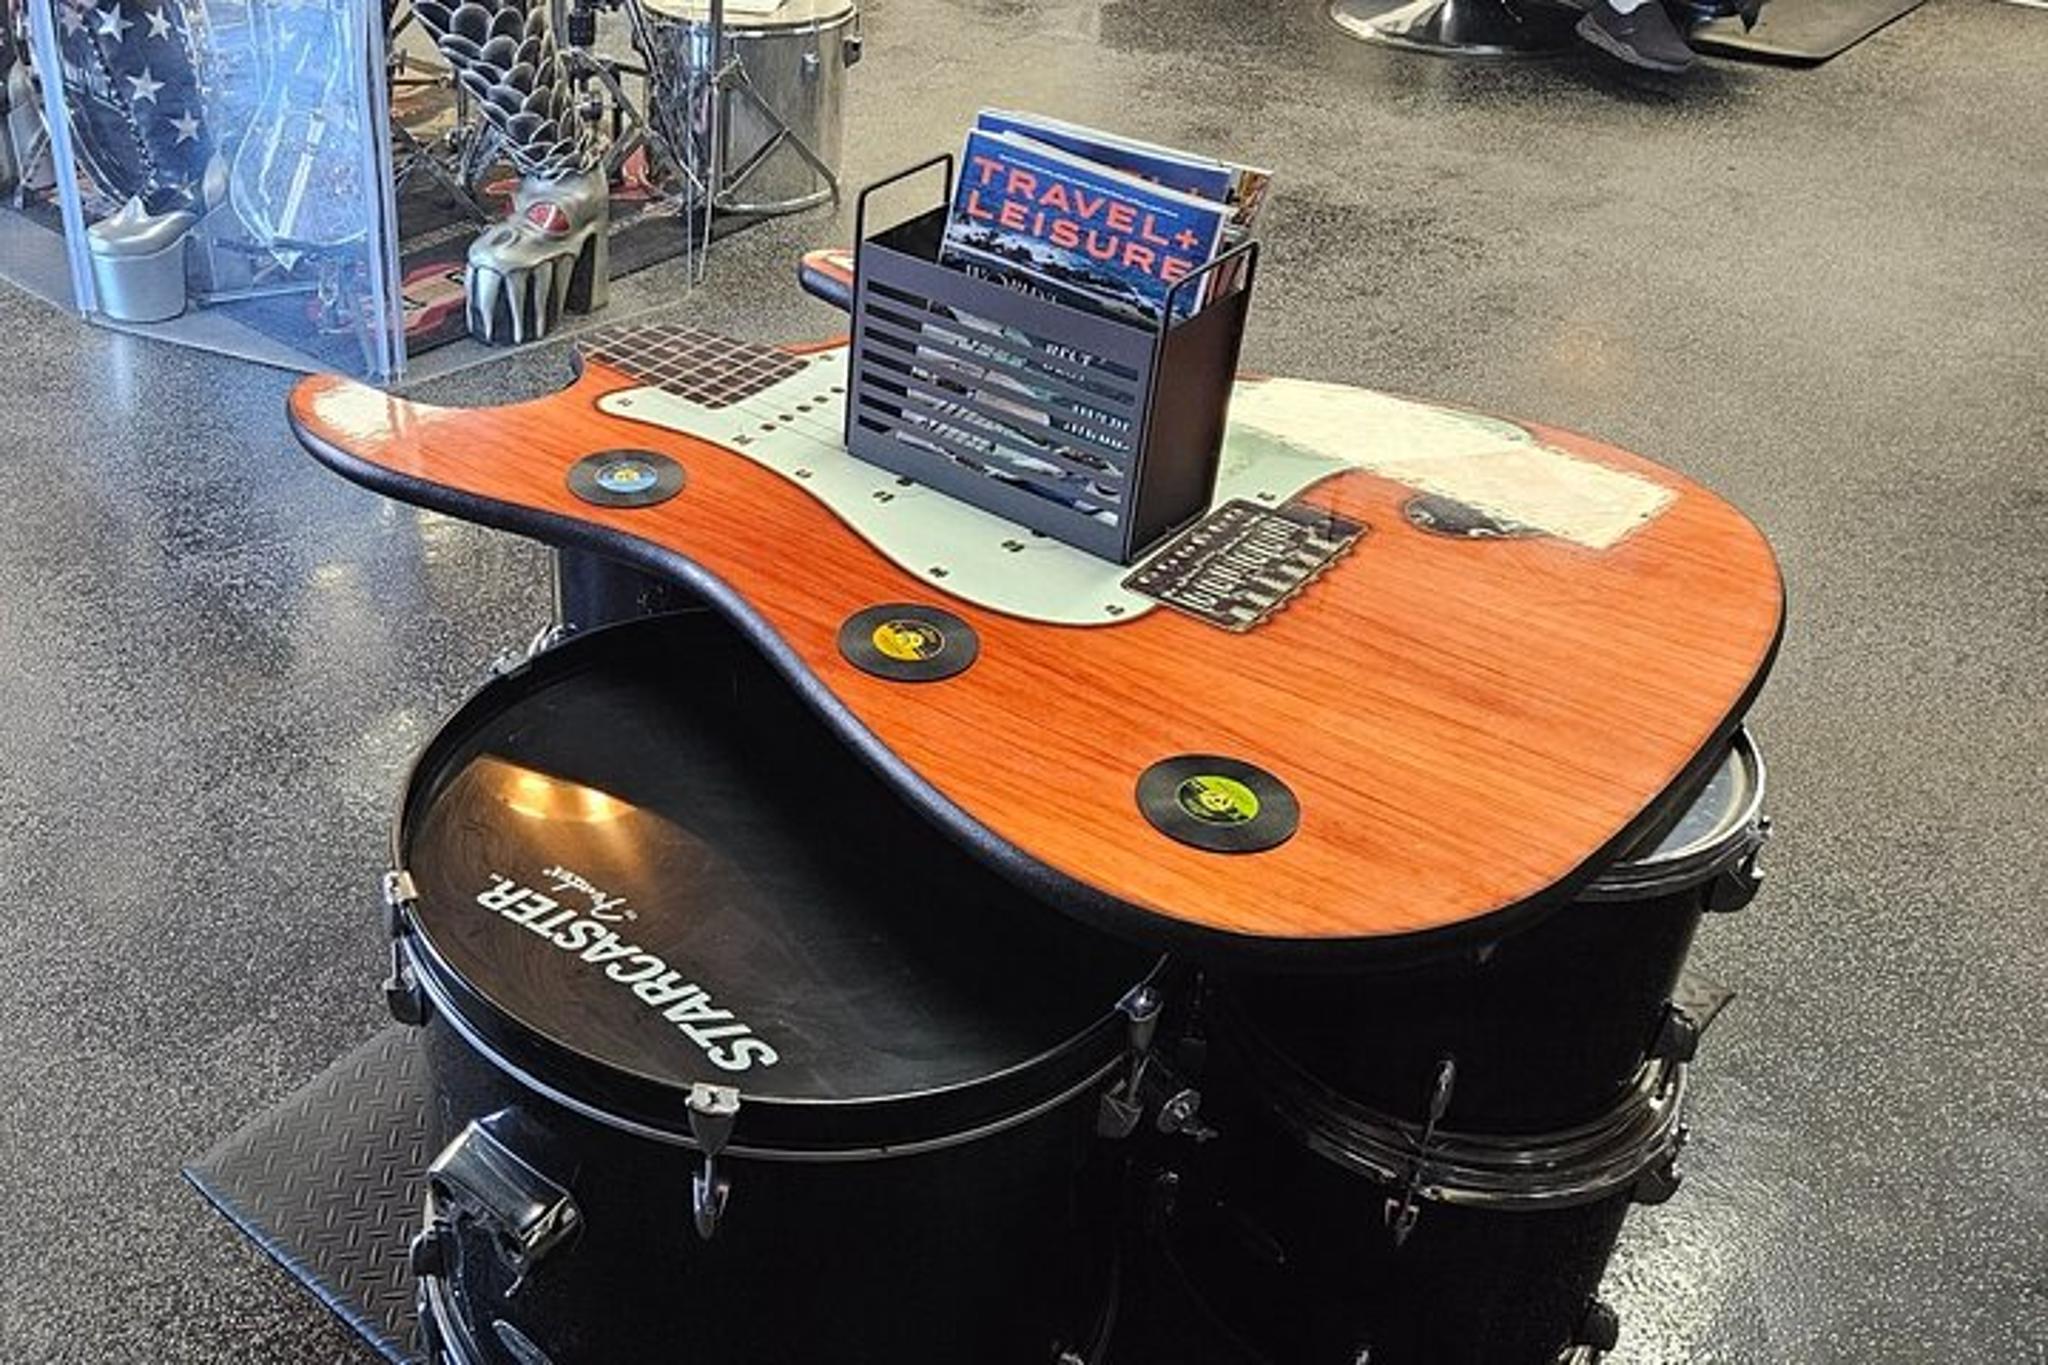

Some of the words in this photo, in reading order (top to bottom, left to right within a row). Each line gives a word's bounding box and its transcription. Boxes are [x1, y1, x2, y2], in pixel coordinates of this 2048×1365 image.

[966, 190, 1193, 283] LEISURE
[974, 156, 1199, 249] TRAVEL+
[477, 880, 779, 1072] STARCASTER
